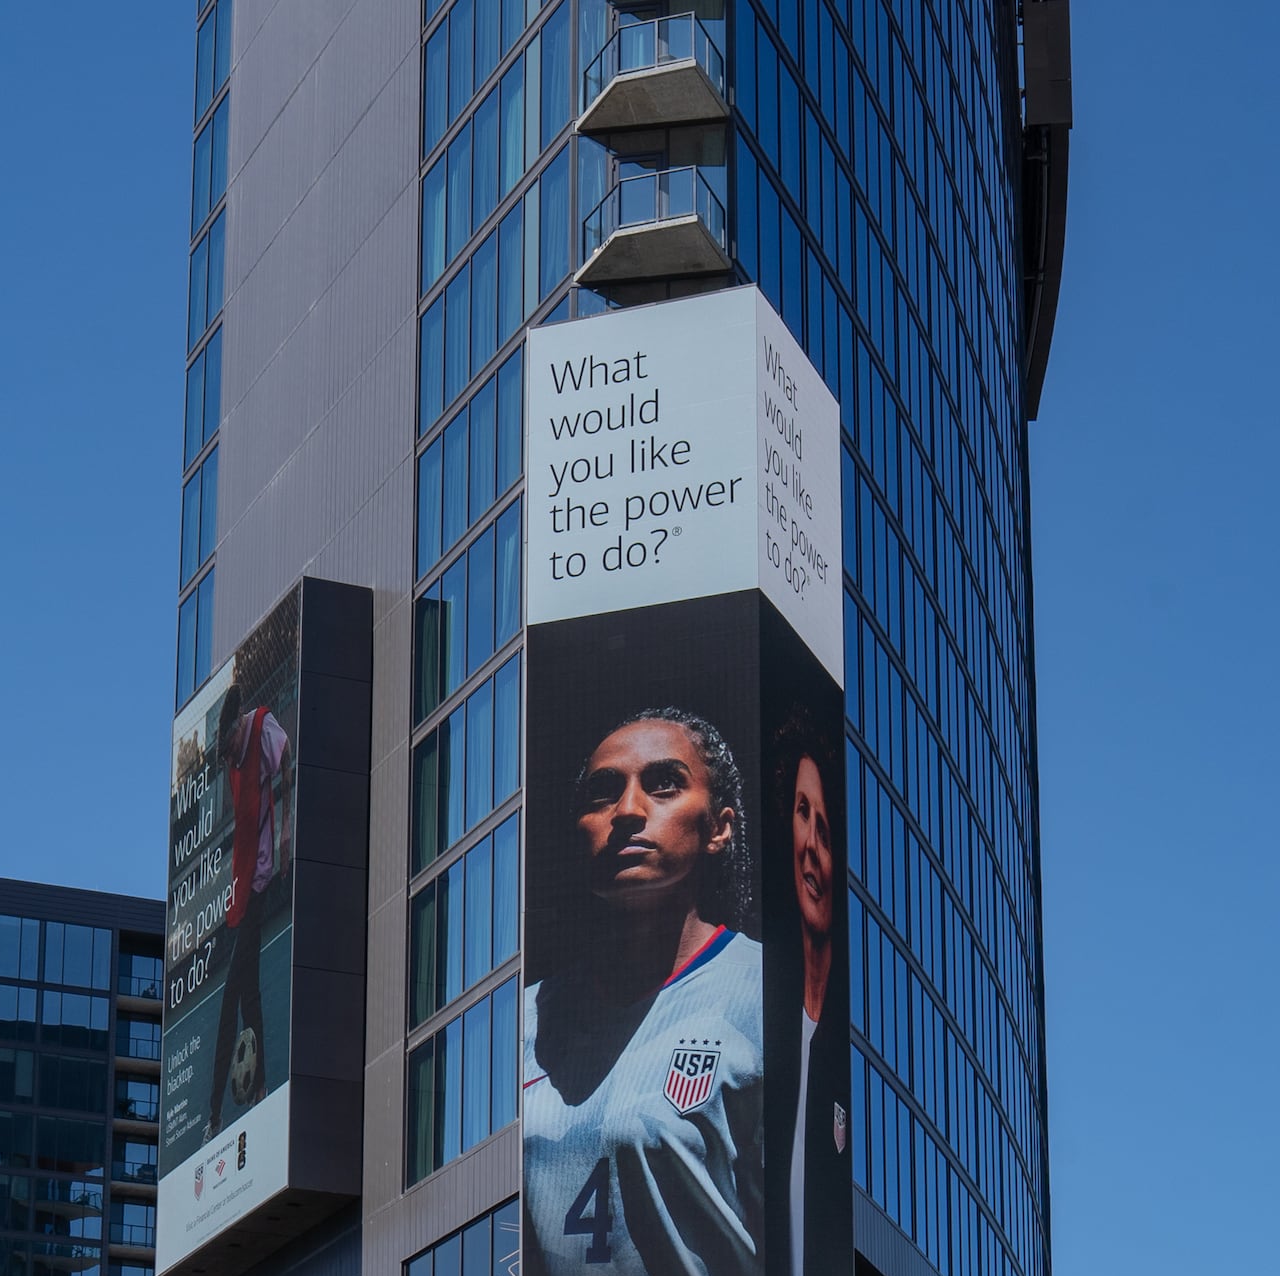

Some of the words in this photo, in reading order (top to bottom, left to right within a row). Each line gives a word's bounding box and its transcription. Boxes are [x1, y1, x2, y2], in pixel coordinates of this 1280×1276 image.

[549, 351, 648, 395] What
[763, 335, 799, 412] What
[549, 388, 660, 441] would
[764, 391, 803, 462] would
[549, 453, 614, 498] you
[630, 435, 691, 473] like
[764, 438, 789, 491] you
[792, 467, 814, 520] like
[549, 498, 609, 533] the
[625, 475, 743, 531] power
[765, 482, 787, 527] the
[791, 519, 828, 585] power
[549, 551, 587, 580] to
[766, 530, 780, 570] to
[174, 763, 210, 820] What
[174, 799, 213, 867] would
[172, 873, 196, 925] you
[199, 846, 222, 889] like
[169, 920, 193, 961] the
[196, 877, 239, 947] power
[170, 976, 184, 1009] to
[673, 1053, 715, 1077] USA
[563, 1157, 613, 1265] 4
